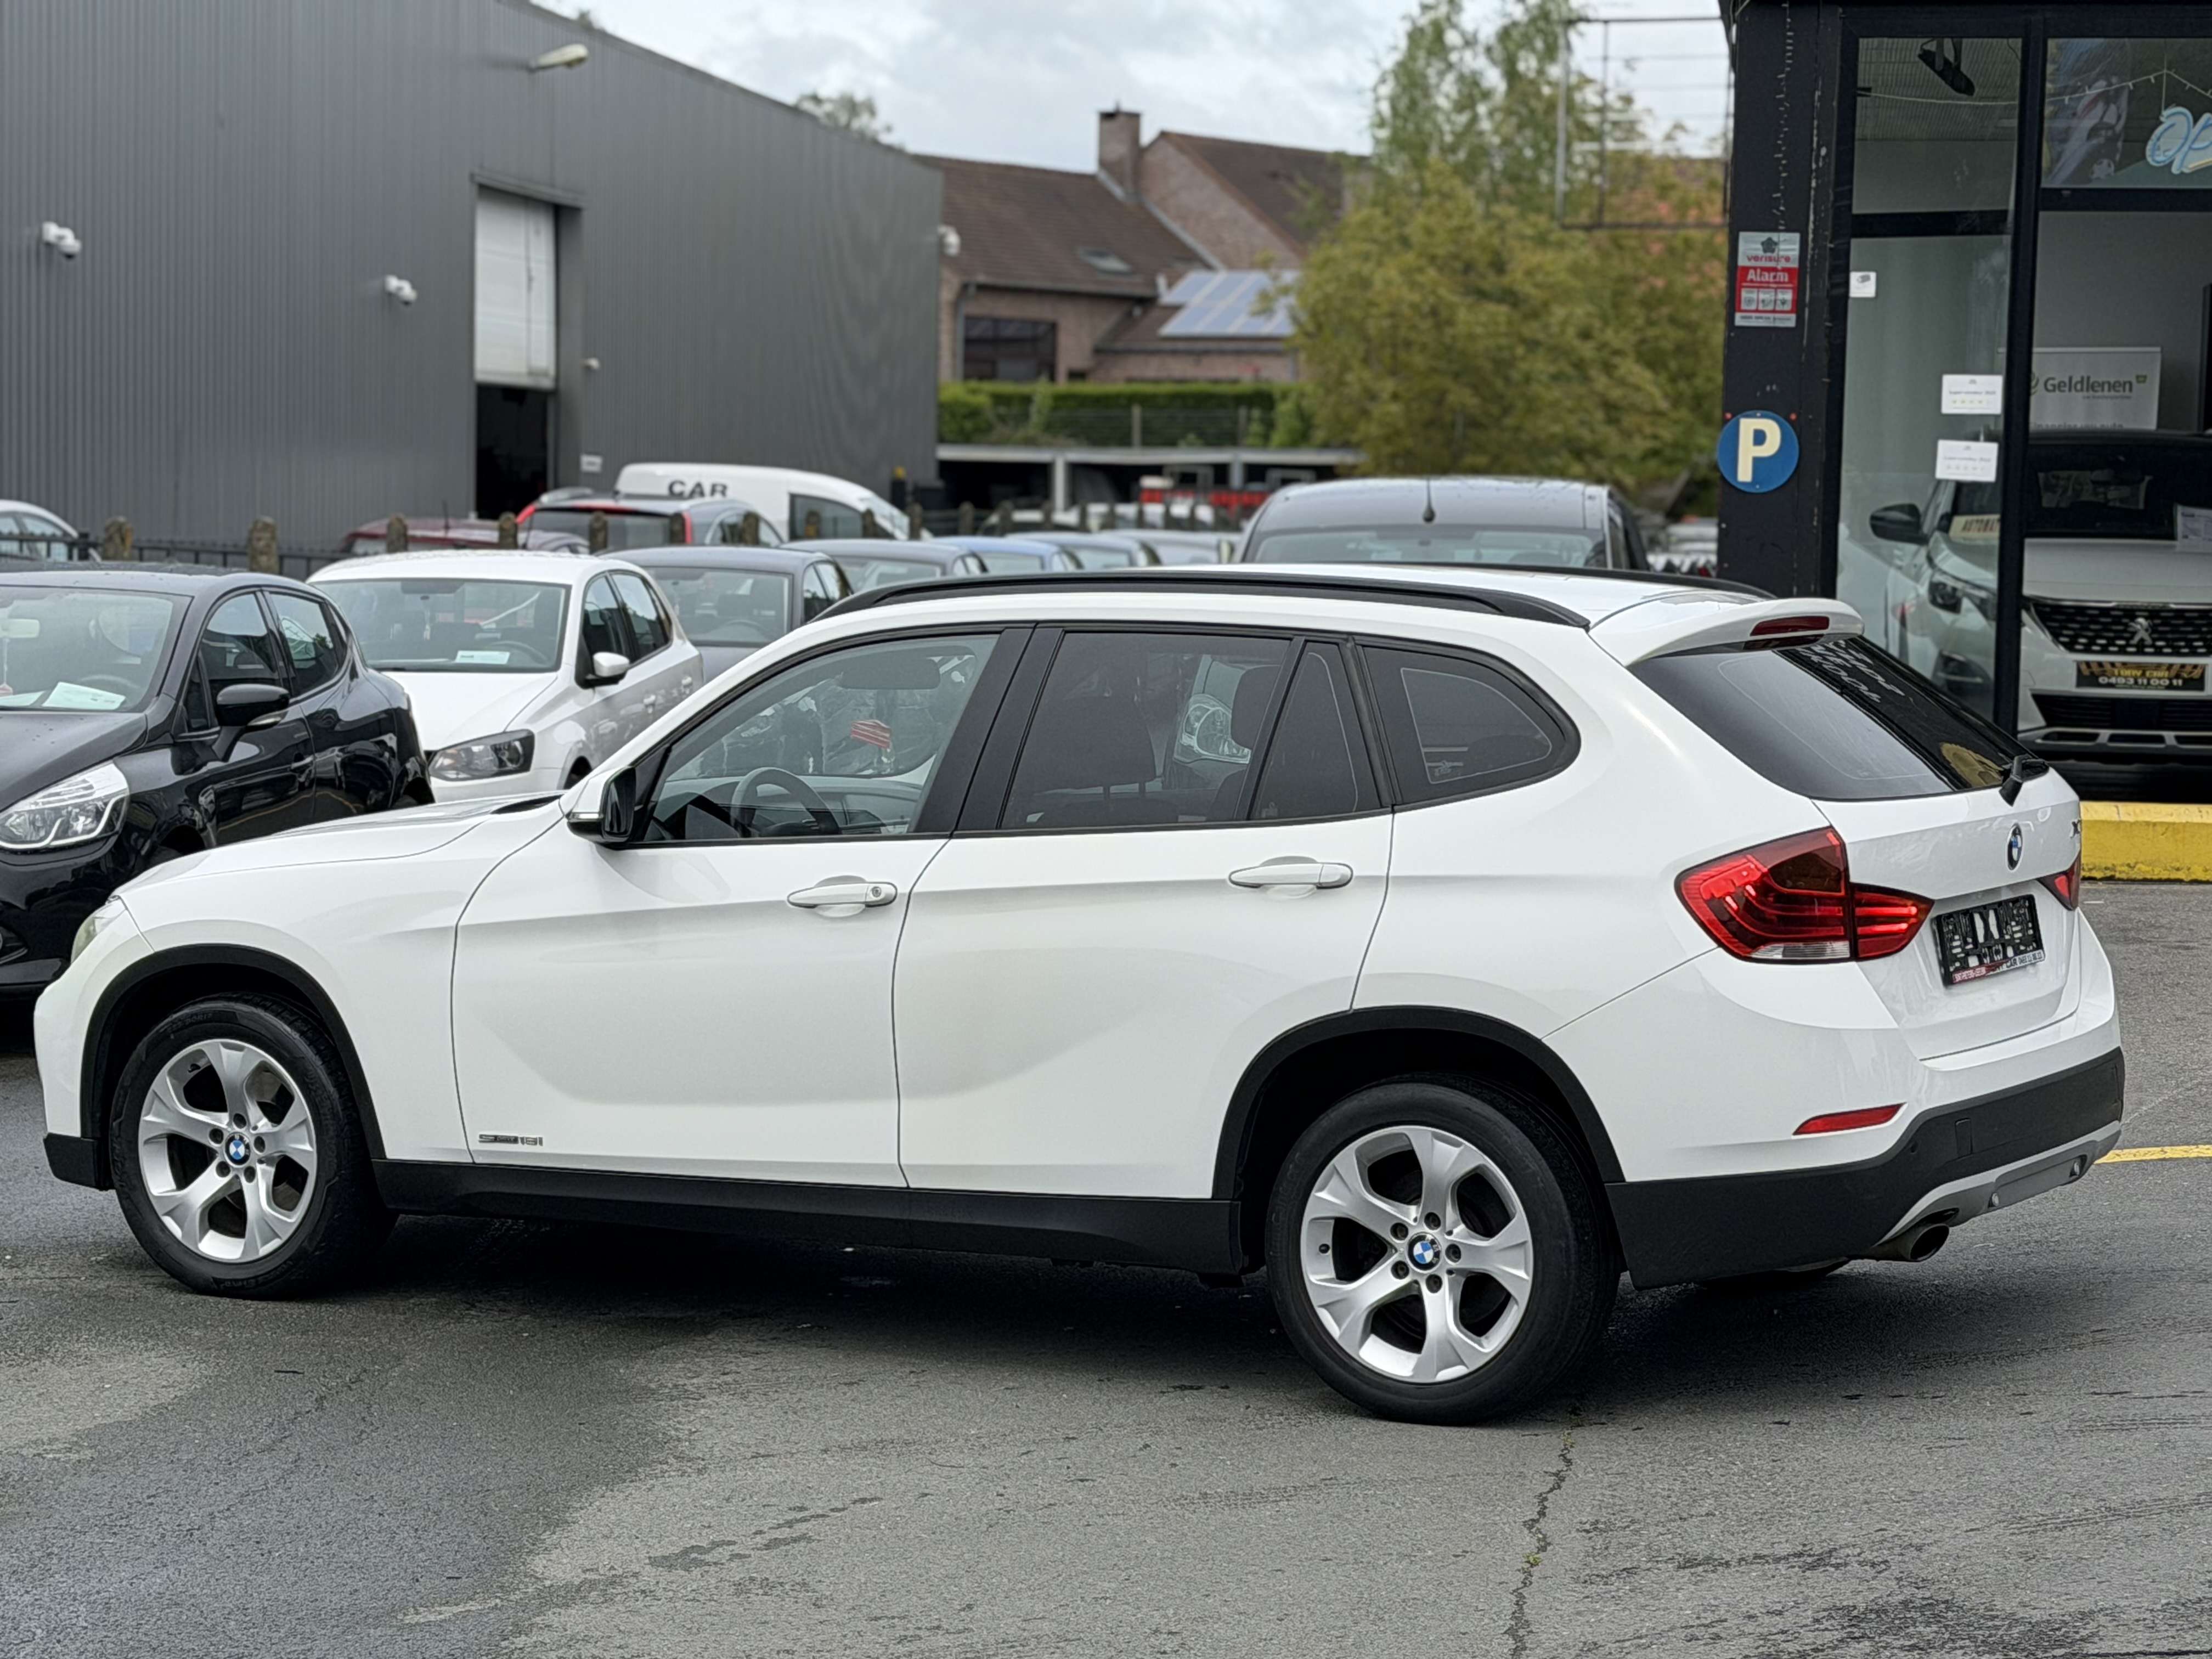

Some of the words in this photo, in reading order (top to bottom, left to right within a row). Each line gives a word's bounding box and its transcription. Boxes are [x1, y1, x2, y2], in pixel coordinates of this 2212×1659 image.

[1746, 268, 1788, 282] Alarm
[2044, 375, 2133, 393] Geldlenen
[1737, 417, 1781, 483] P
[668, 480, 728, 499] CAR
